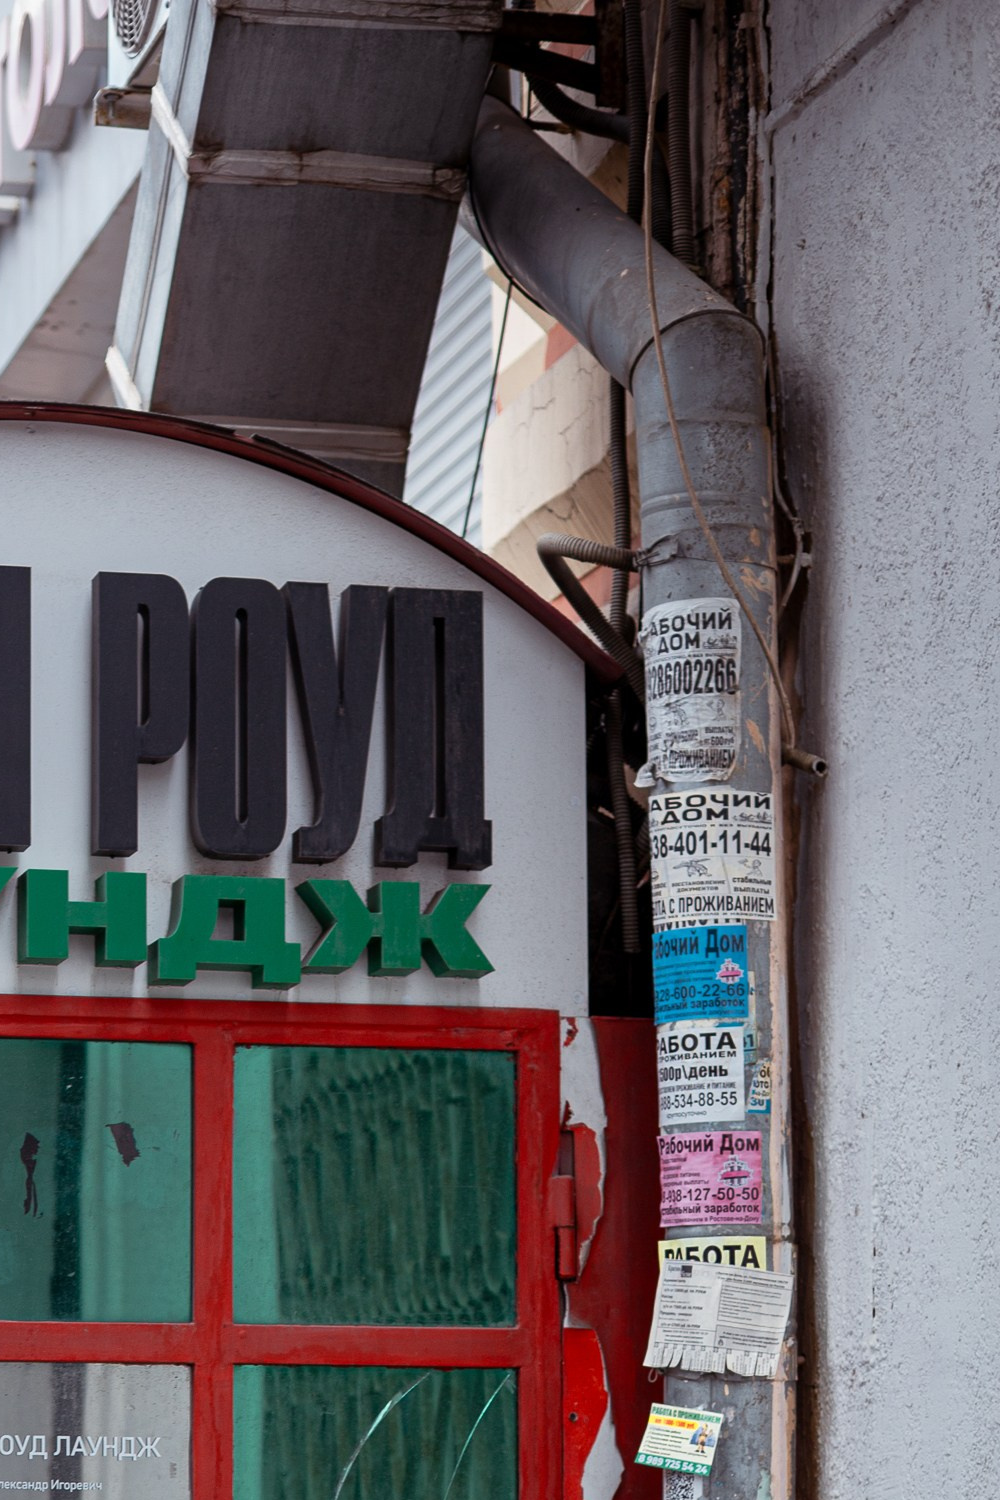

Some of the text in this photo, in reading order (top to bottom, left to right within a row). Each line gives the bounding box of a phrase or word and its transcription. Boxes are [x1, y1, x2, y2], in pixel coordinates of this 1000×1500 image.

[658, 632, 700, 655] ДОМ
[648, 658, 737, 699] 286002266
[91, 571, 493, 871] РОУД
[651, 793, 770, 811] АБОЧИЙ
[661, 808, 729, 825] ДОМ
[669, 898, 676, 914] С
[678, 895, 775, 914] ПРОЖИВАНИЕМ
[705, 929, 744, 958] Дом
[659, 1133, 760, 1156] Рабочий Дом
[704, 1202, 760, 1216] заработок
[53, 1434, 161, 1461] ЛАУНДЖ
[50, 1478, 103, 1493] Игоревич
